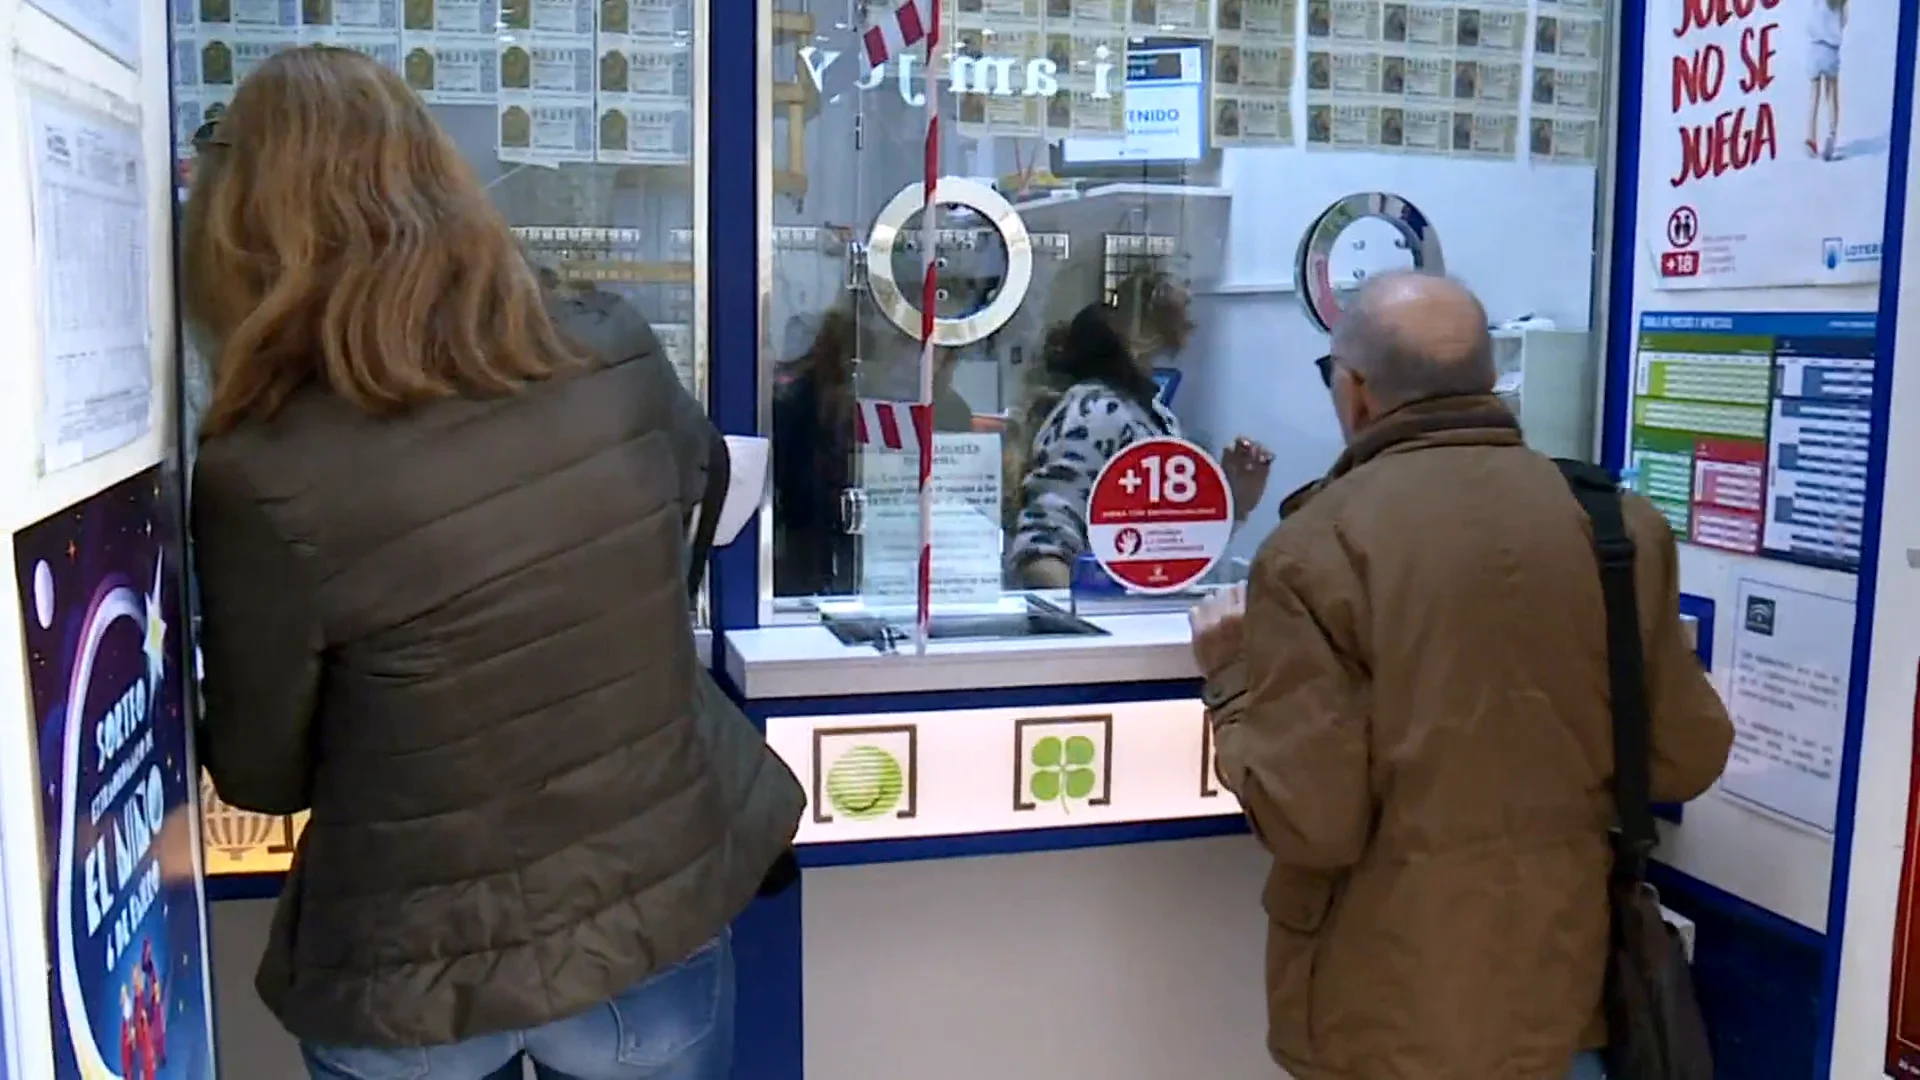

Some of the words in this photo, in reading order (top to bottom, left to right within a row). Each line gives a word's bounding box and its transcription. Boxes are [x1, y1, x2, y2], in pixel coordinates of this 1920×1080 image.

[1672, 44, 1724, 113] NO
[1739, 23, 1779, 94] SE
[1670, 103, 1777, 188] JUEGA
[1664, 254, 1694, 274] +18
[1118, 455, 1198, 503] +18
[96, 677, 146, 773] SORTEO
[85, 834, 114, 938] EL
